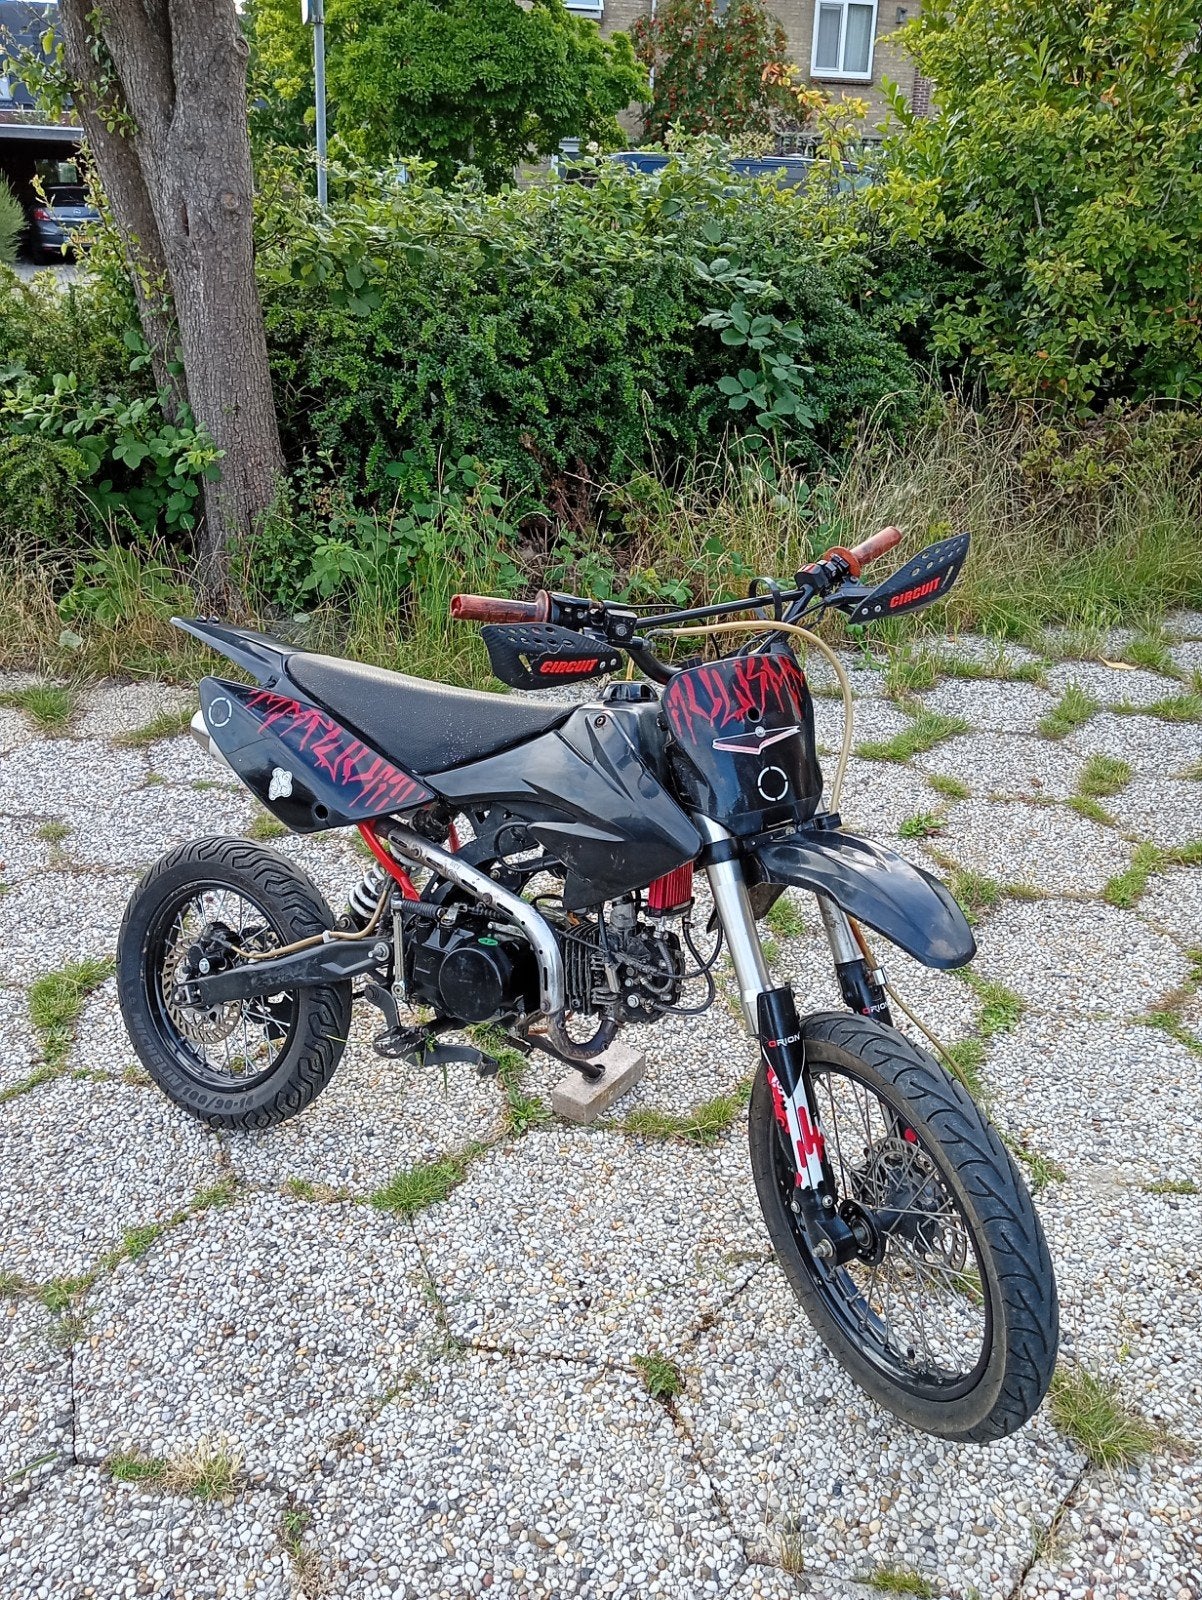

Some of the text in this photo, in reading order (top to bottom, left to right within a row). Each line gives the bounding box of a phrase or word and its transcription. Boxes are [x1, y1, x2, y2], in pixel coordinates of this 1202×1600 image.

[889, 577, 941, 608] CIRCUIT
[539, 659, 599, 674] CIRCUIT
[131, 1012, 182, 1086] MICHELIN
[768, 1031, 800, 1047] ORION
